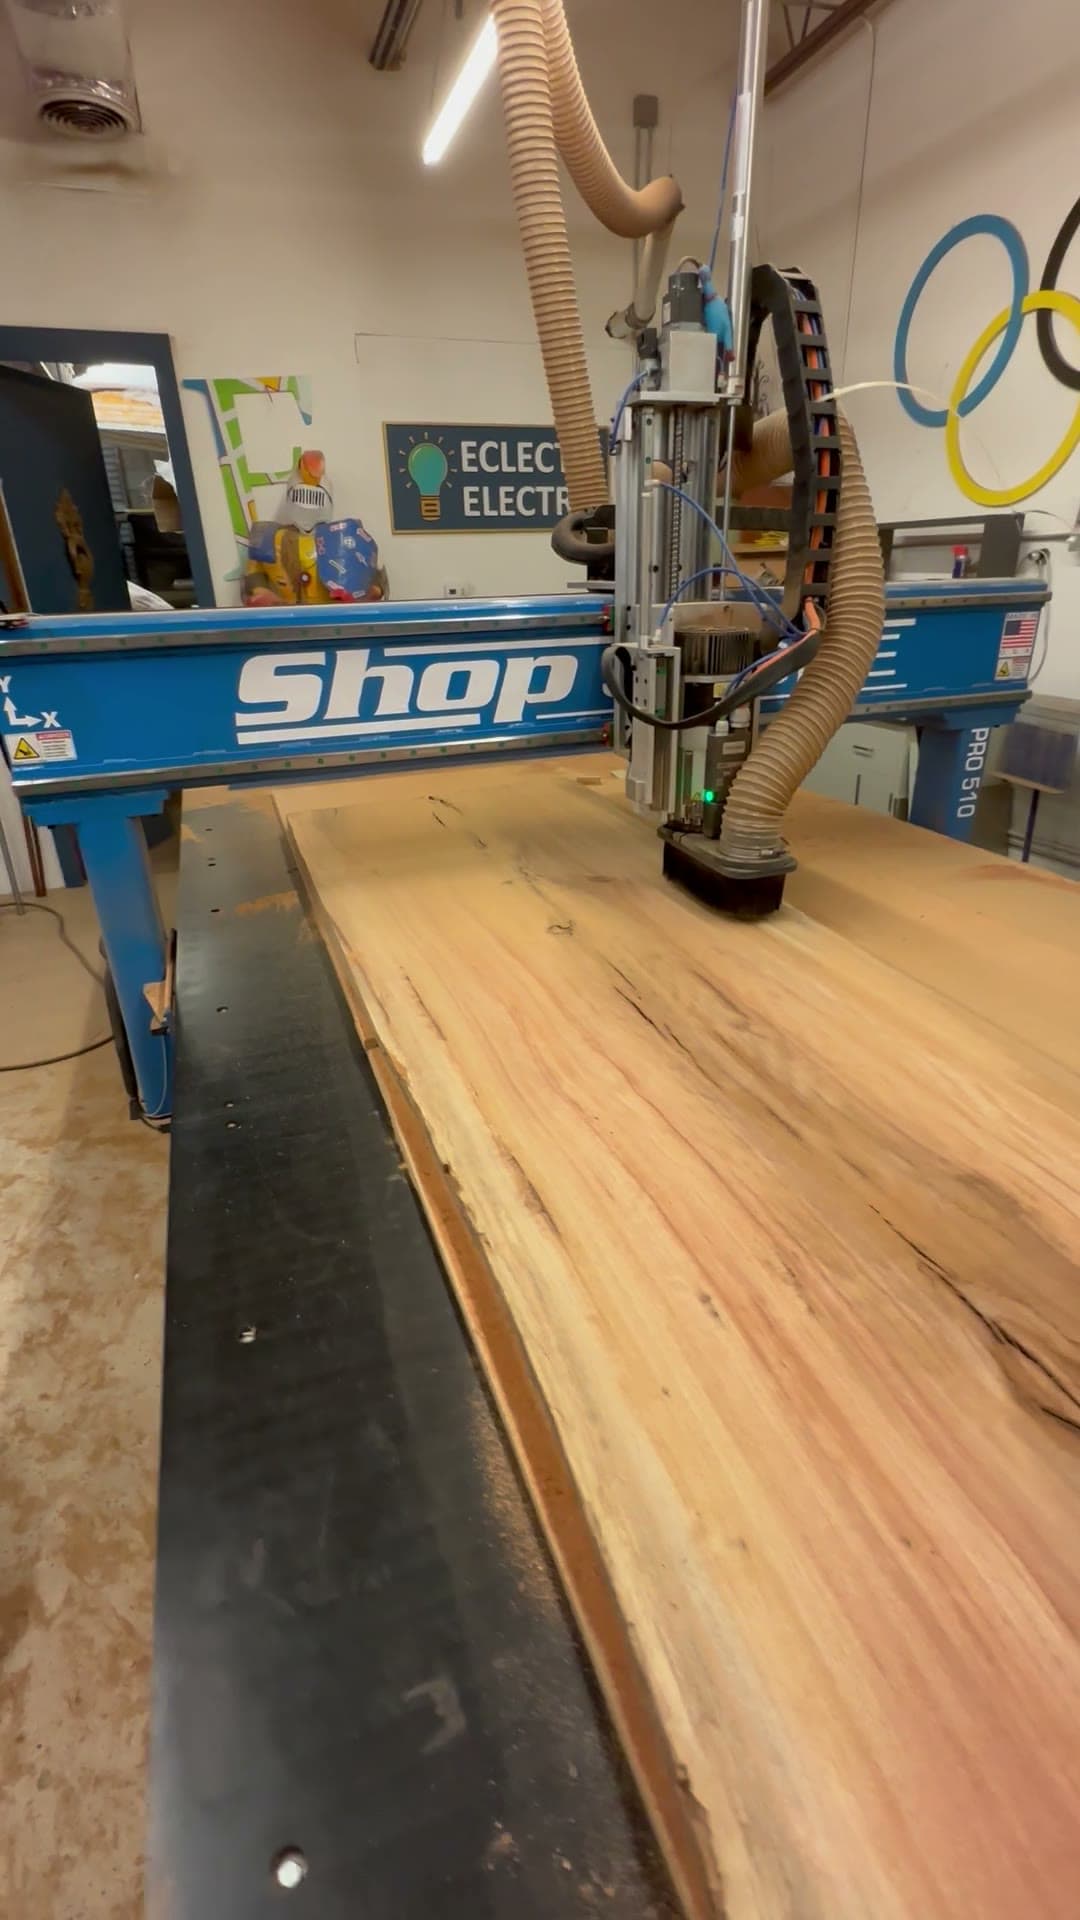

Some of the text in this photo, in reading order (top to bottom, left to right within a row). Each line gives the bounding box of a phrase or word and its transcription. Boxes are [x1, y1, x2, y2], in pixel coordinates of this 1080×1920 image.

[463, 486, 571, 516] ELECTR
[0, 676, 12, 693] Y
[235, 649, 578, 724] Shop
[41, 711, 61, 728] X
[957, 728, 990, 818] PRO 510
